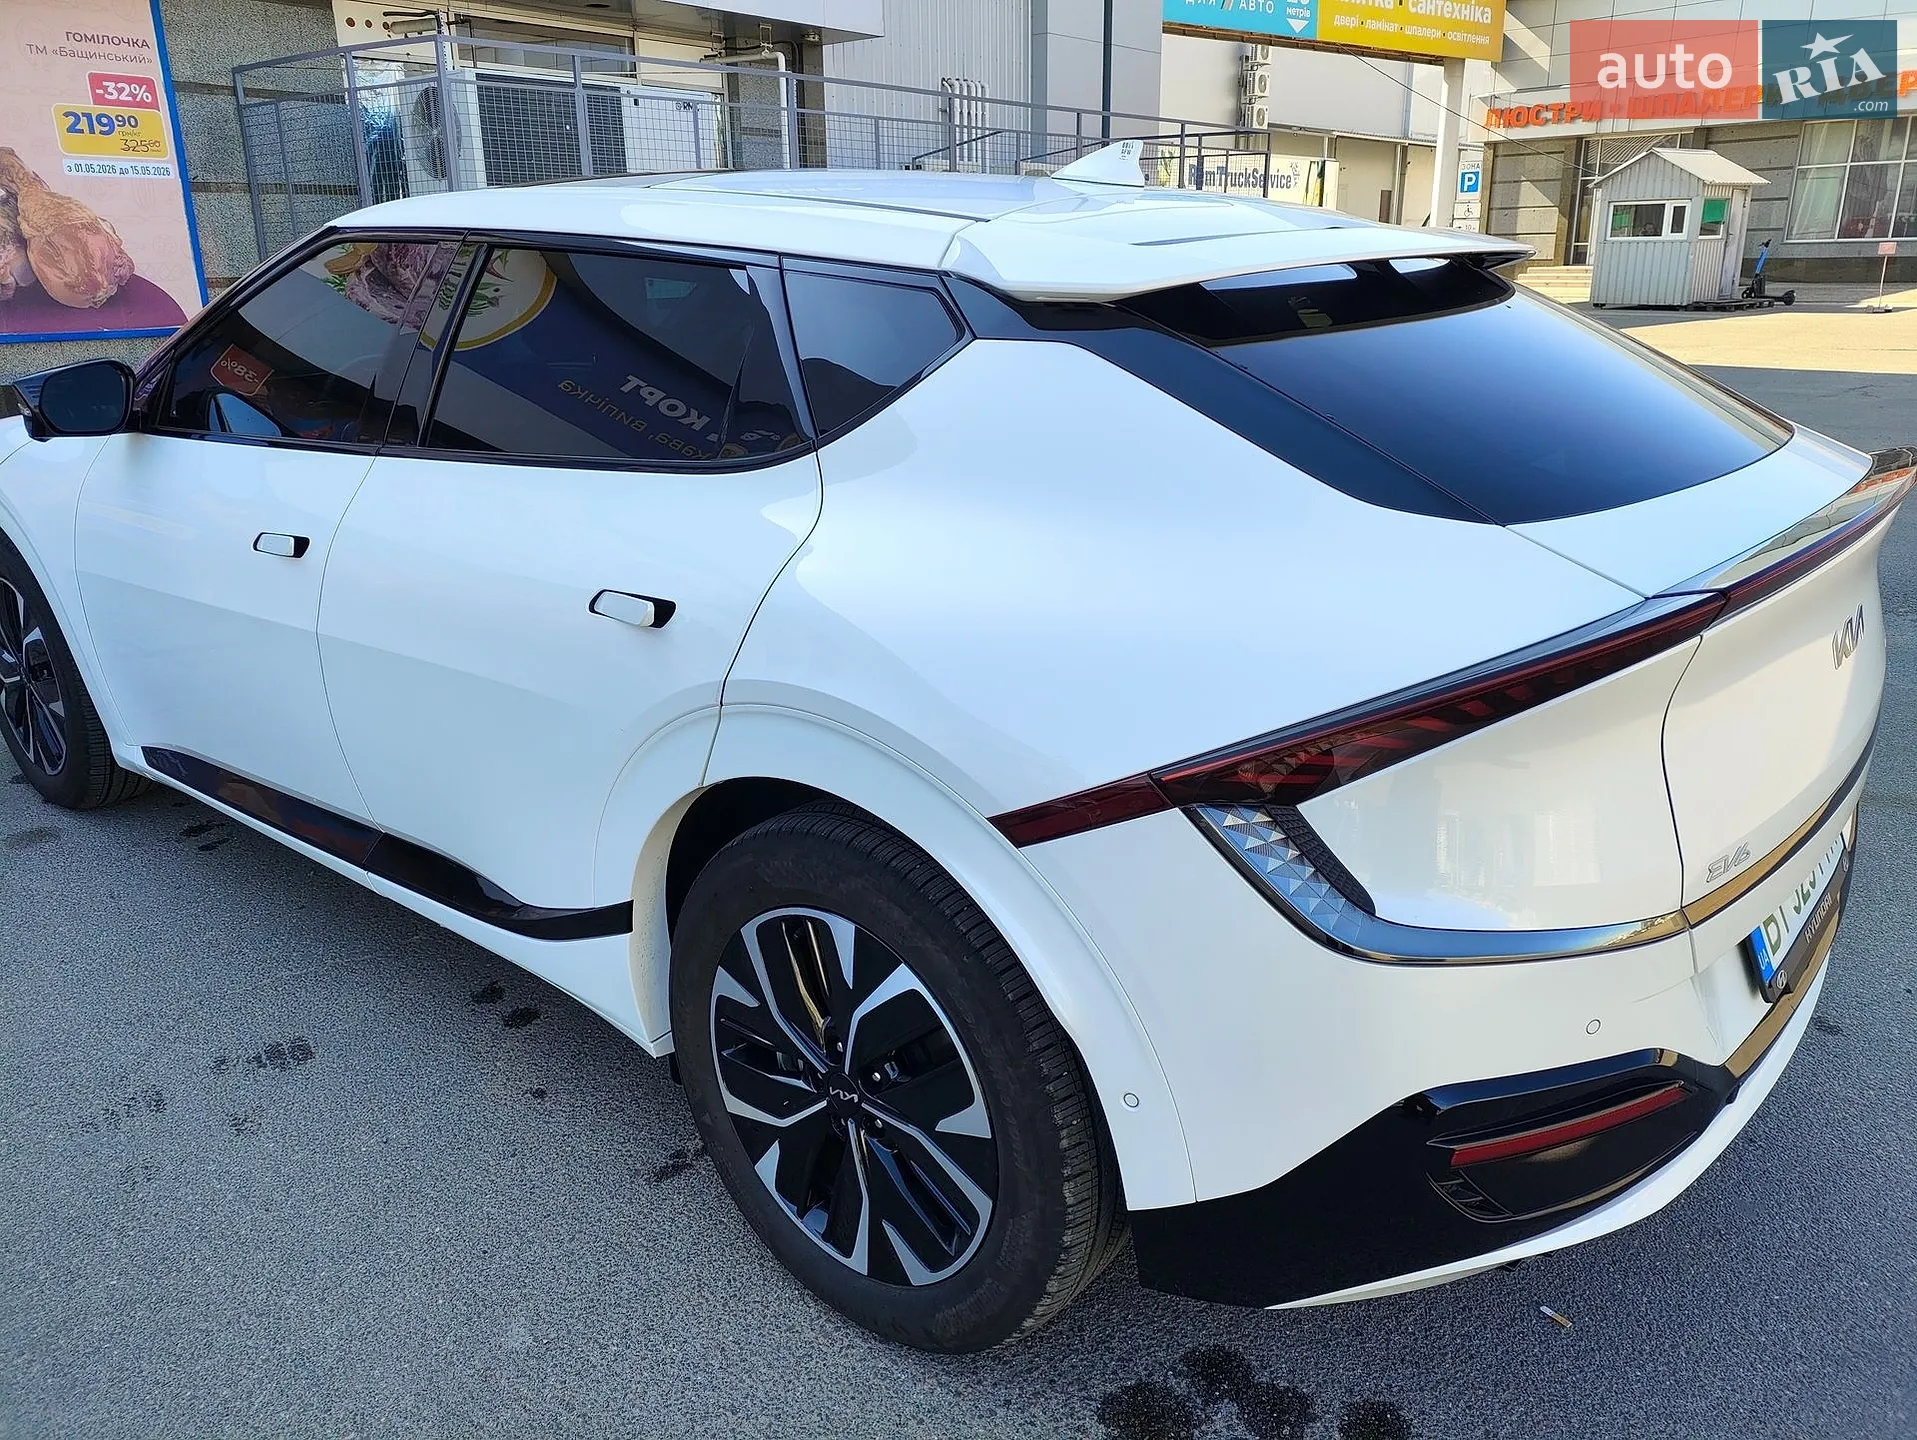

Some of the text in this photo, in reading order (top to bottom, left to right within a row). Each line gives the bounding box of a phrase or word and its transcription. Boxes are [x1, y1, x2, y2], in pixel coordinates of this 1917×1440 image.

[1238, 0, 1275, 14] АВТО
[1286, 7, 1311, 18] метрів
[65, 31, 151, 50] ГОМІЛОЧКА
[1333, 14, 1490, 45] двері ламінат шпалери освітлення
[26, 43, 153, 65] ТМ «Бащинський»
[95, 81, 153, 103] -32%
[1485, 101, 1602, 128] ЛЮСТРИ
[74, 162, 117, 174] 01.05.2026
[119, 167, 130, 176] до
[130, 165, 171, 177] 15.05.2026
[1188, 162, 1292, 189] RmTruckSevice
[1705, 841, 1752, 884] EV6
[1804, 891, 1833, 944] HYUNDAI
[1757, 951, 1770, 971] UA
